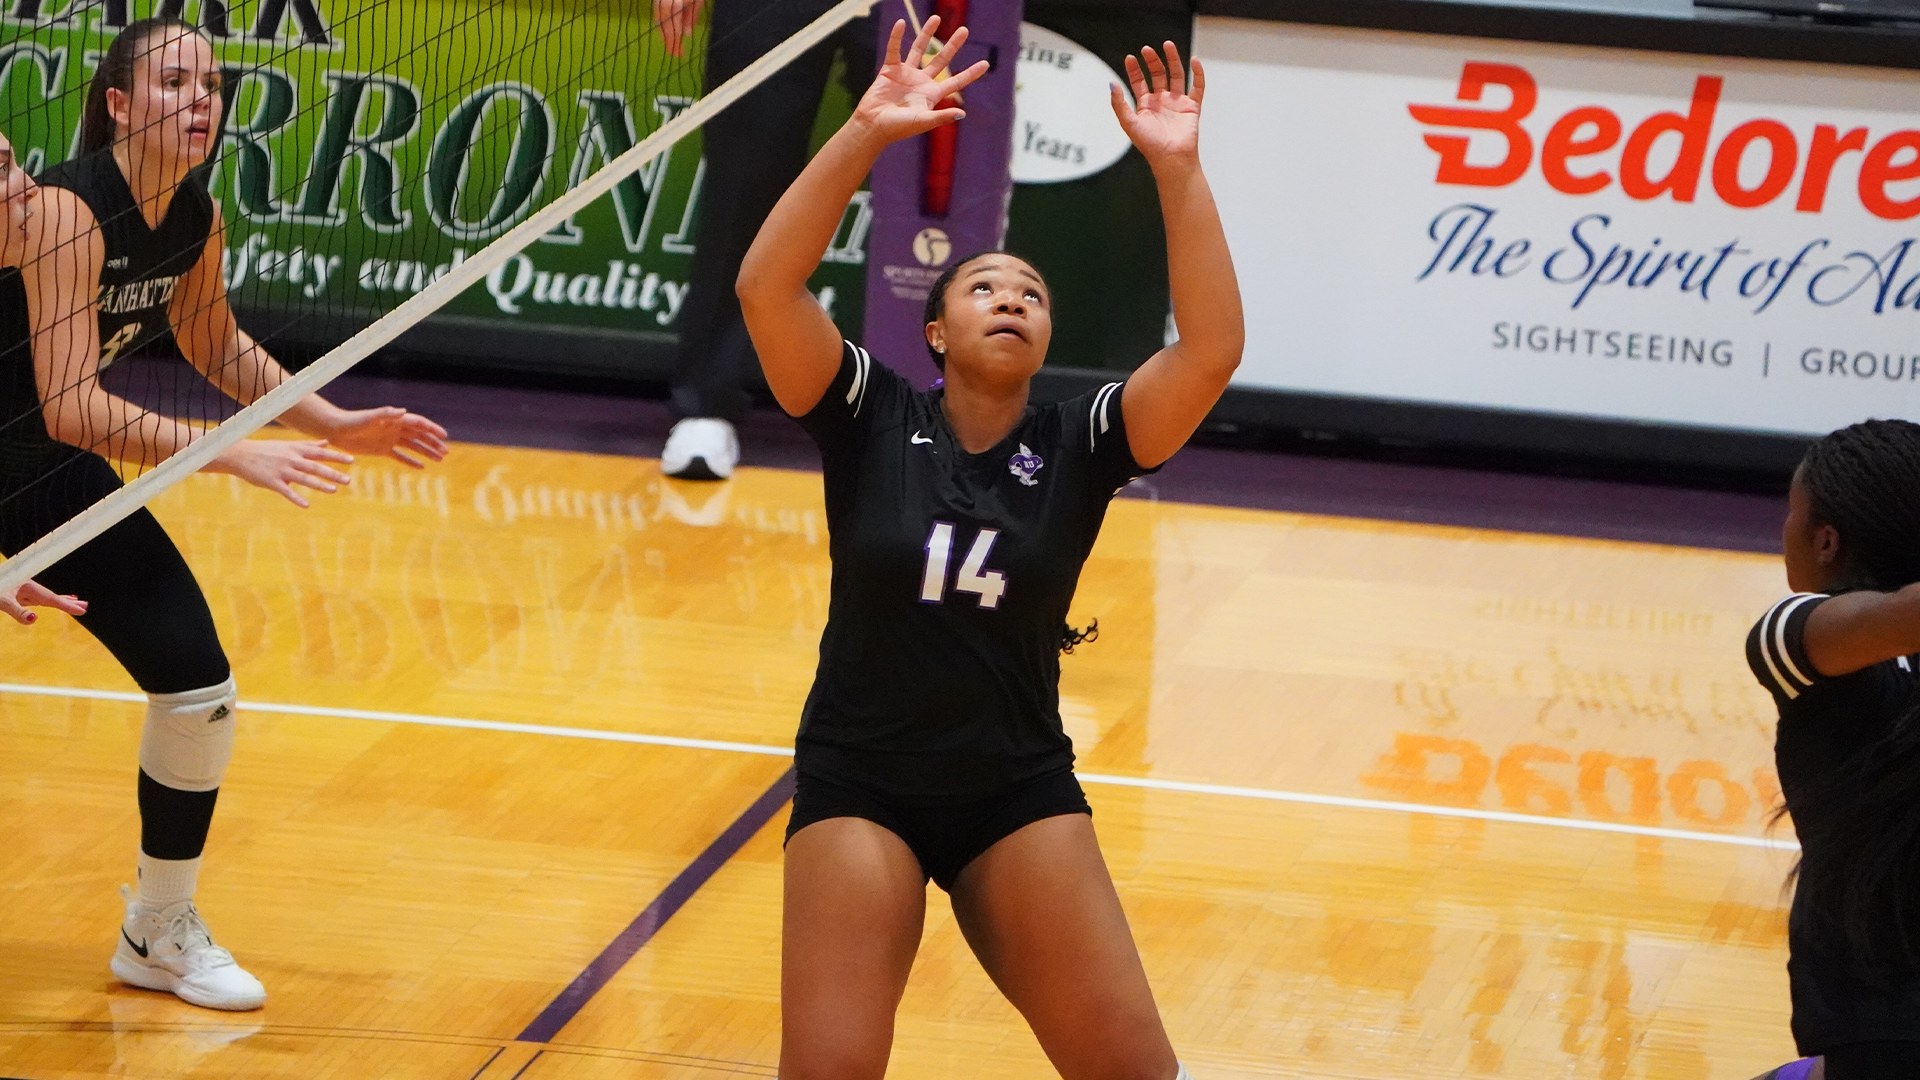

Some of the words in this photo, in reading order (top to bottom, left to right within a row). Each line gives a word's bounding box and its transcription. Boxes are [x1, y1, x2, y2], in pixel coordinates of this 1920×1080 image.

[1018, 41, 1073, 70] ing
[1023, 119, 1087, 164] Years
[1407, 60, 1920, 220] Bedore
[222, 231, 342, 299] fety
[486, 252, 690, 325] Quality
[1415, 204, 1531, 283] The
[1543, 213, 1752, 310] Spirit
[1738, 238, 1830, 316] of
[1491, 321, 1734, 367] SIGHTSEEING
[919, 519, 1009, 611] 14
